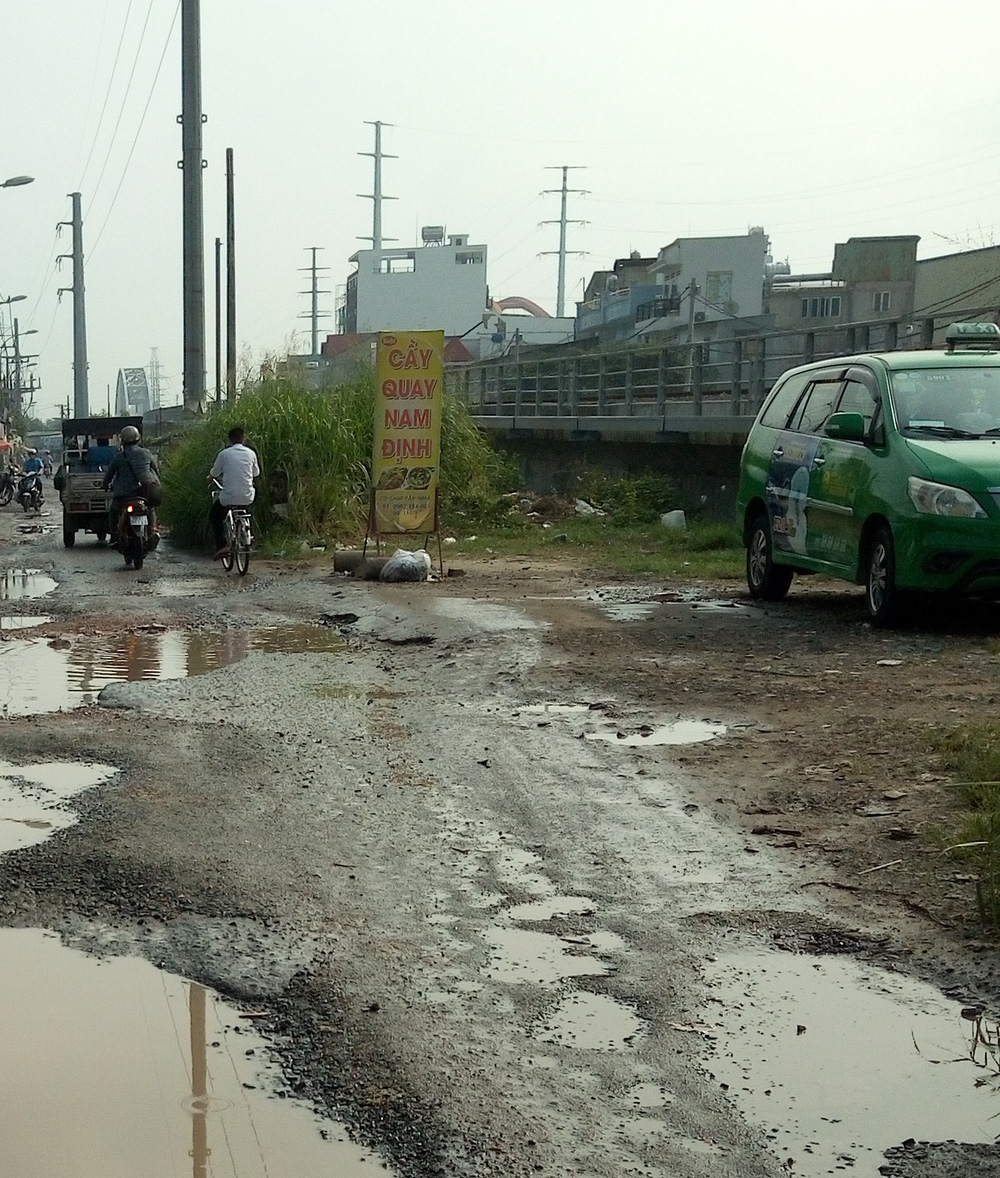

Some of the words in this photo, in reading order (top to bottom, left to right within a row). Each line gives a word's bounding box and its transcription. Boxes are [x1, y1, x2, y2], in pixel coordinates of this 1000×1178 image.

[388, 339, 434, 370] CẦY
[381, 378, 437, 400] QUAY
[384, 408, 432, 430] NAM
[381, 438, 432, 463] ĐỊNH
